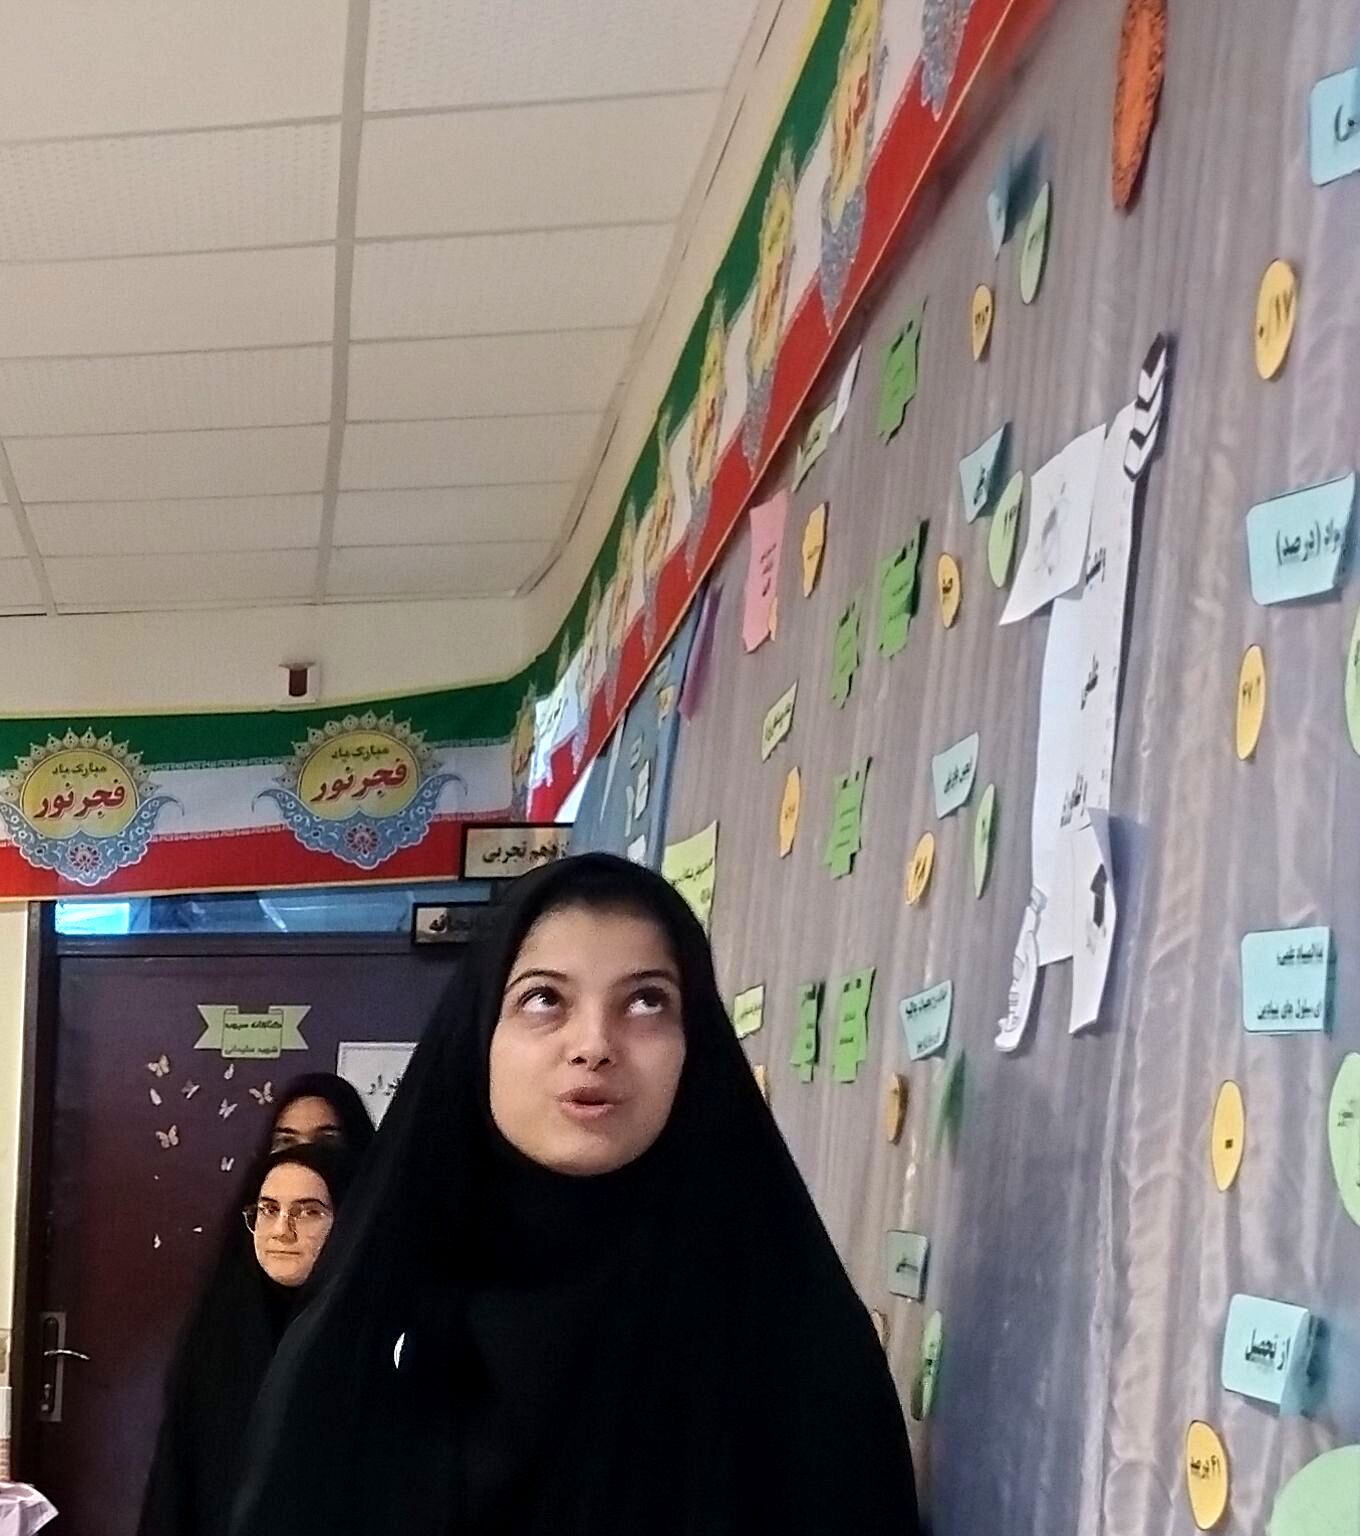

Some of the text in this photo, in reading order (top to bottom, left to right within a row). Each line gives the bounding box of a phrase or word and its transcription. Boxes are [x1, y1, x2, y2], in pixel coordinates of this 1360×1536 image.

[331, 745, 390, 760] مبارک باد
[52, 761, 108, 778] مبارک باد
[310, 758, 408, 802] فجر نور
[33, 779, 126, 820] فجر نور
[481, 838, 528, 864] تجربی
